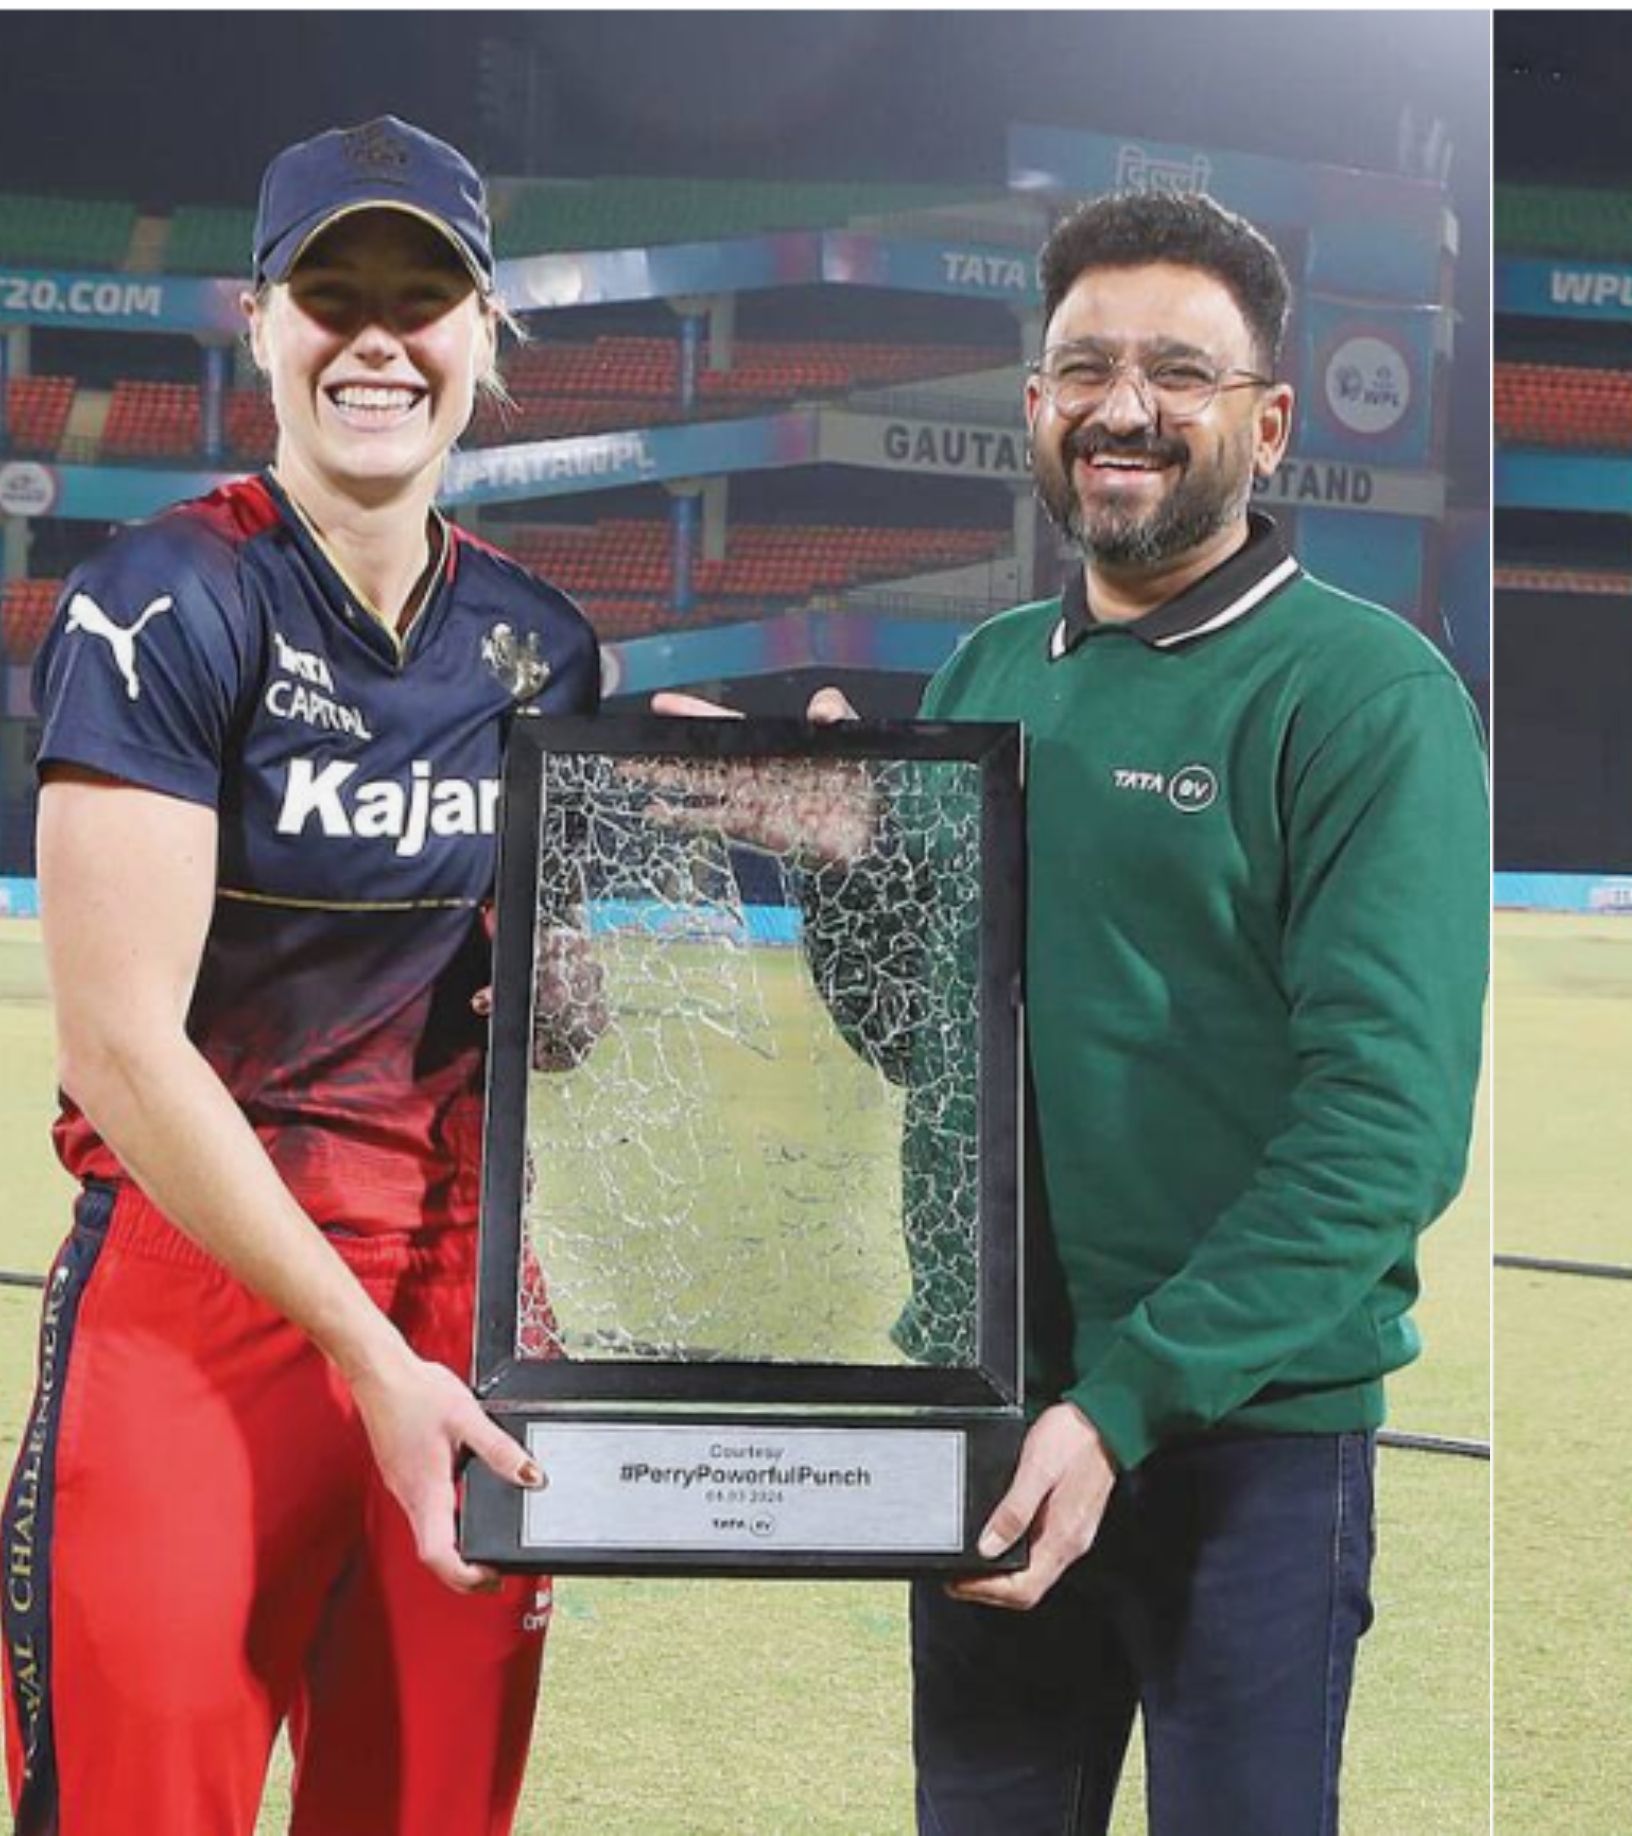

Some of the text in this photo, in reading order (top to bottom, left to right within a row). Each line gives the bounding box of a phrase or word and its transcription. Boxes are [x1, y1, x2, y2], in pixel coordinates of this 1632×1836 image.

[942, 253, 1025, 288] TATA
[884, 423, 1033, 472] GAUTA
[264, 680, 373, 741] CAPITAL
[1113, 768, 1164, 793] TATA
[709, 1443, 785, 1461] Courtesy
[620, 1463, 871, 1489] #PerryPowerfulPunch
